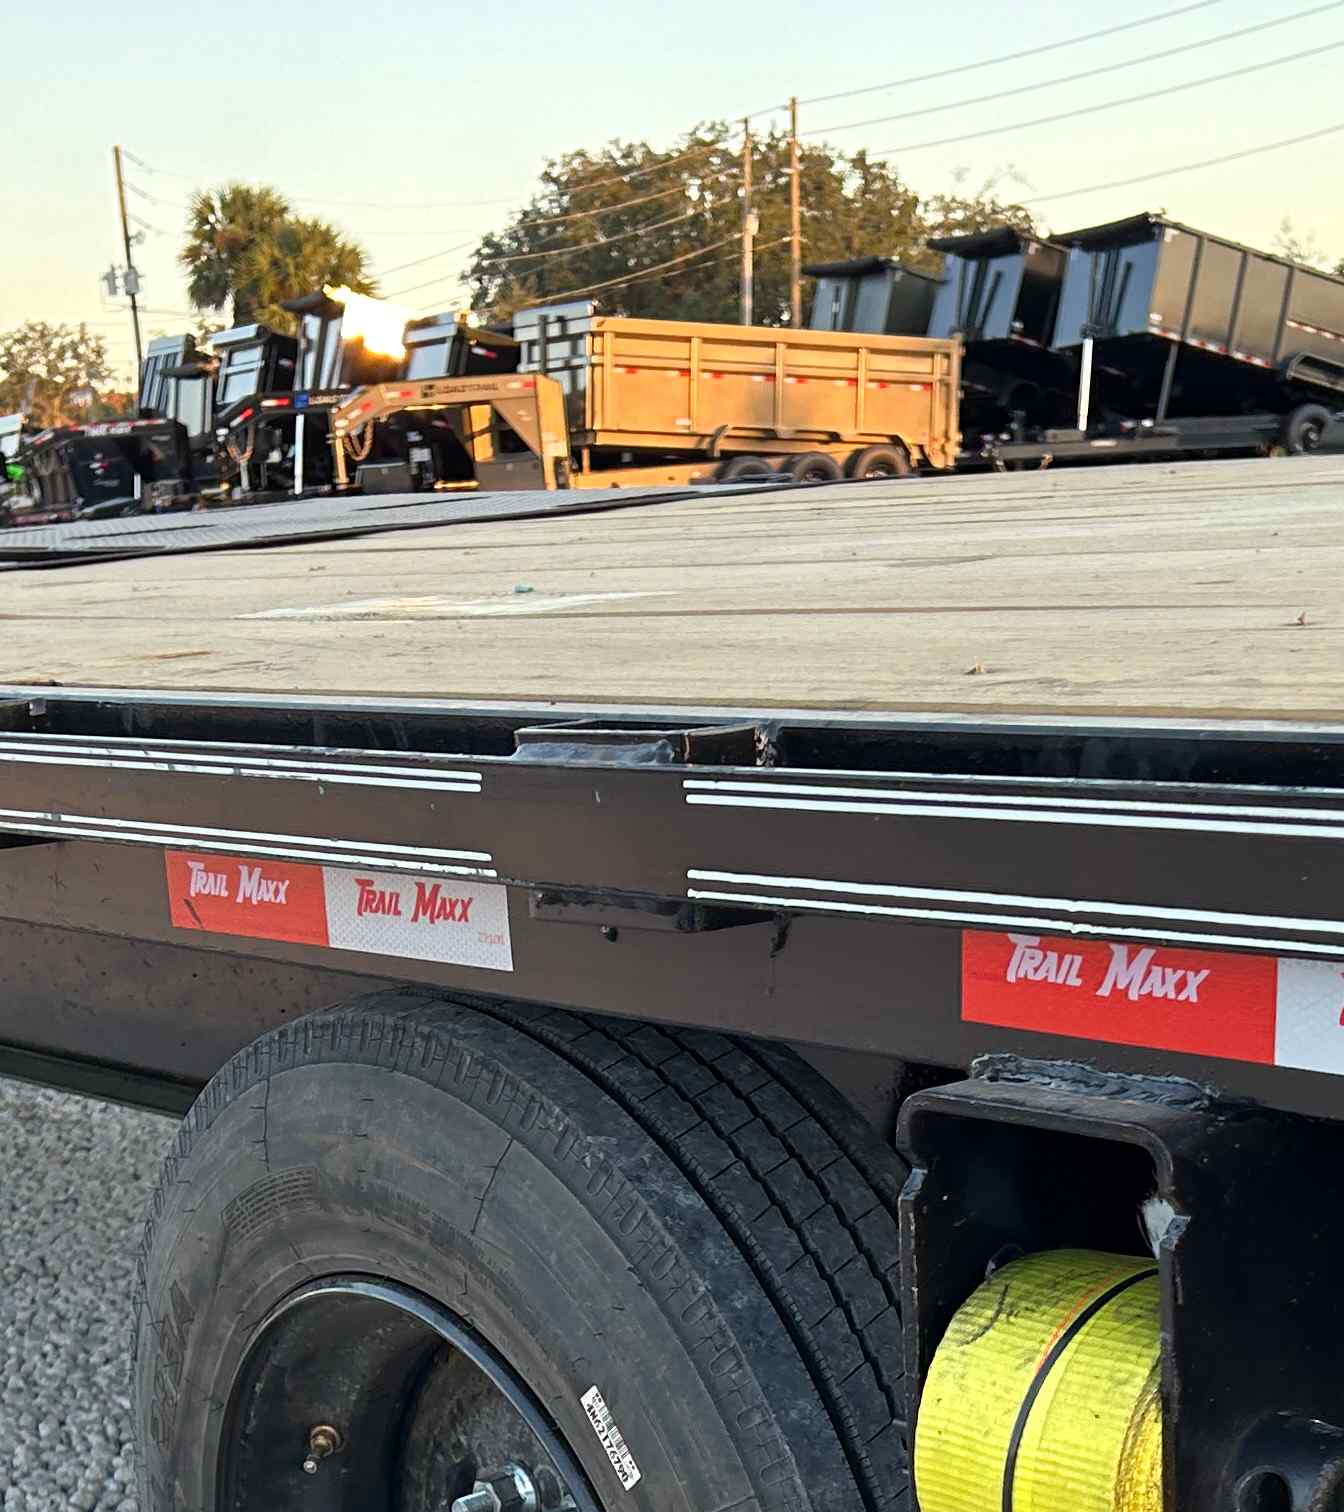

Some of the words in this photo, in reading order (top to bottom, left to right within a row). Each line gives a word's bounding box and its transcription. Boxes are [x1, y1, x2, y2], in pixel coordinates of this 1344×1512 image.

[186, 860, 229, 898] TRAIL
[235, 863, 290, 905] MAXX
[354, 877, 402, 917] TRAIL
[410, 881, 474, 925] MAXX
[1005, 933, 1083, 987] TRAIL
[1096, 943, 1211, 1003] MAXX
